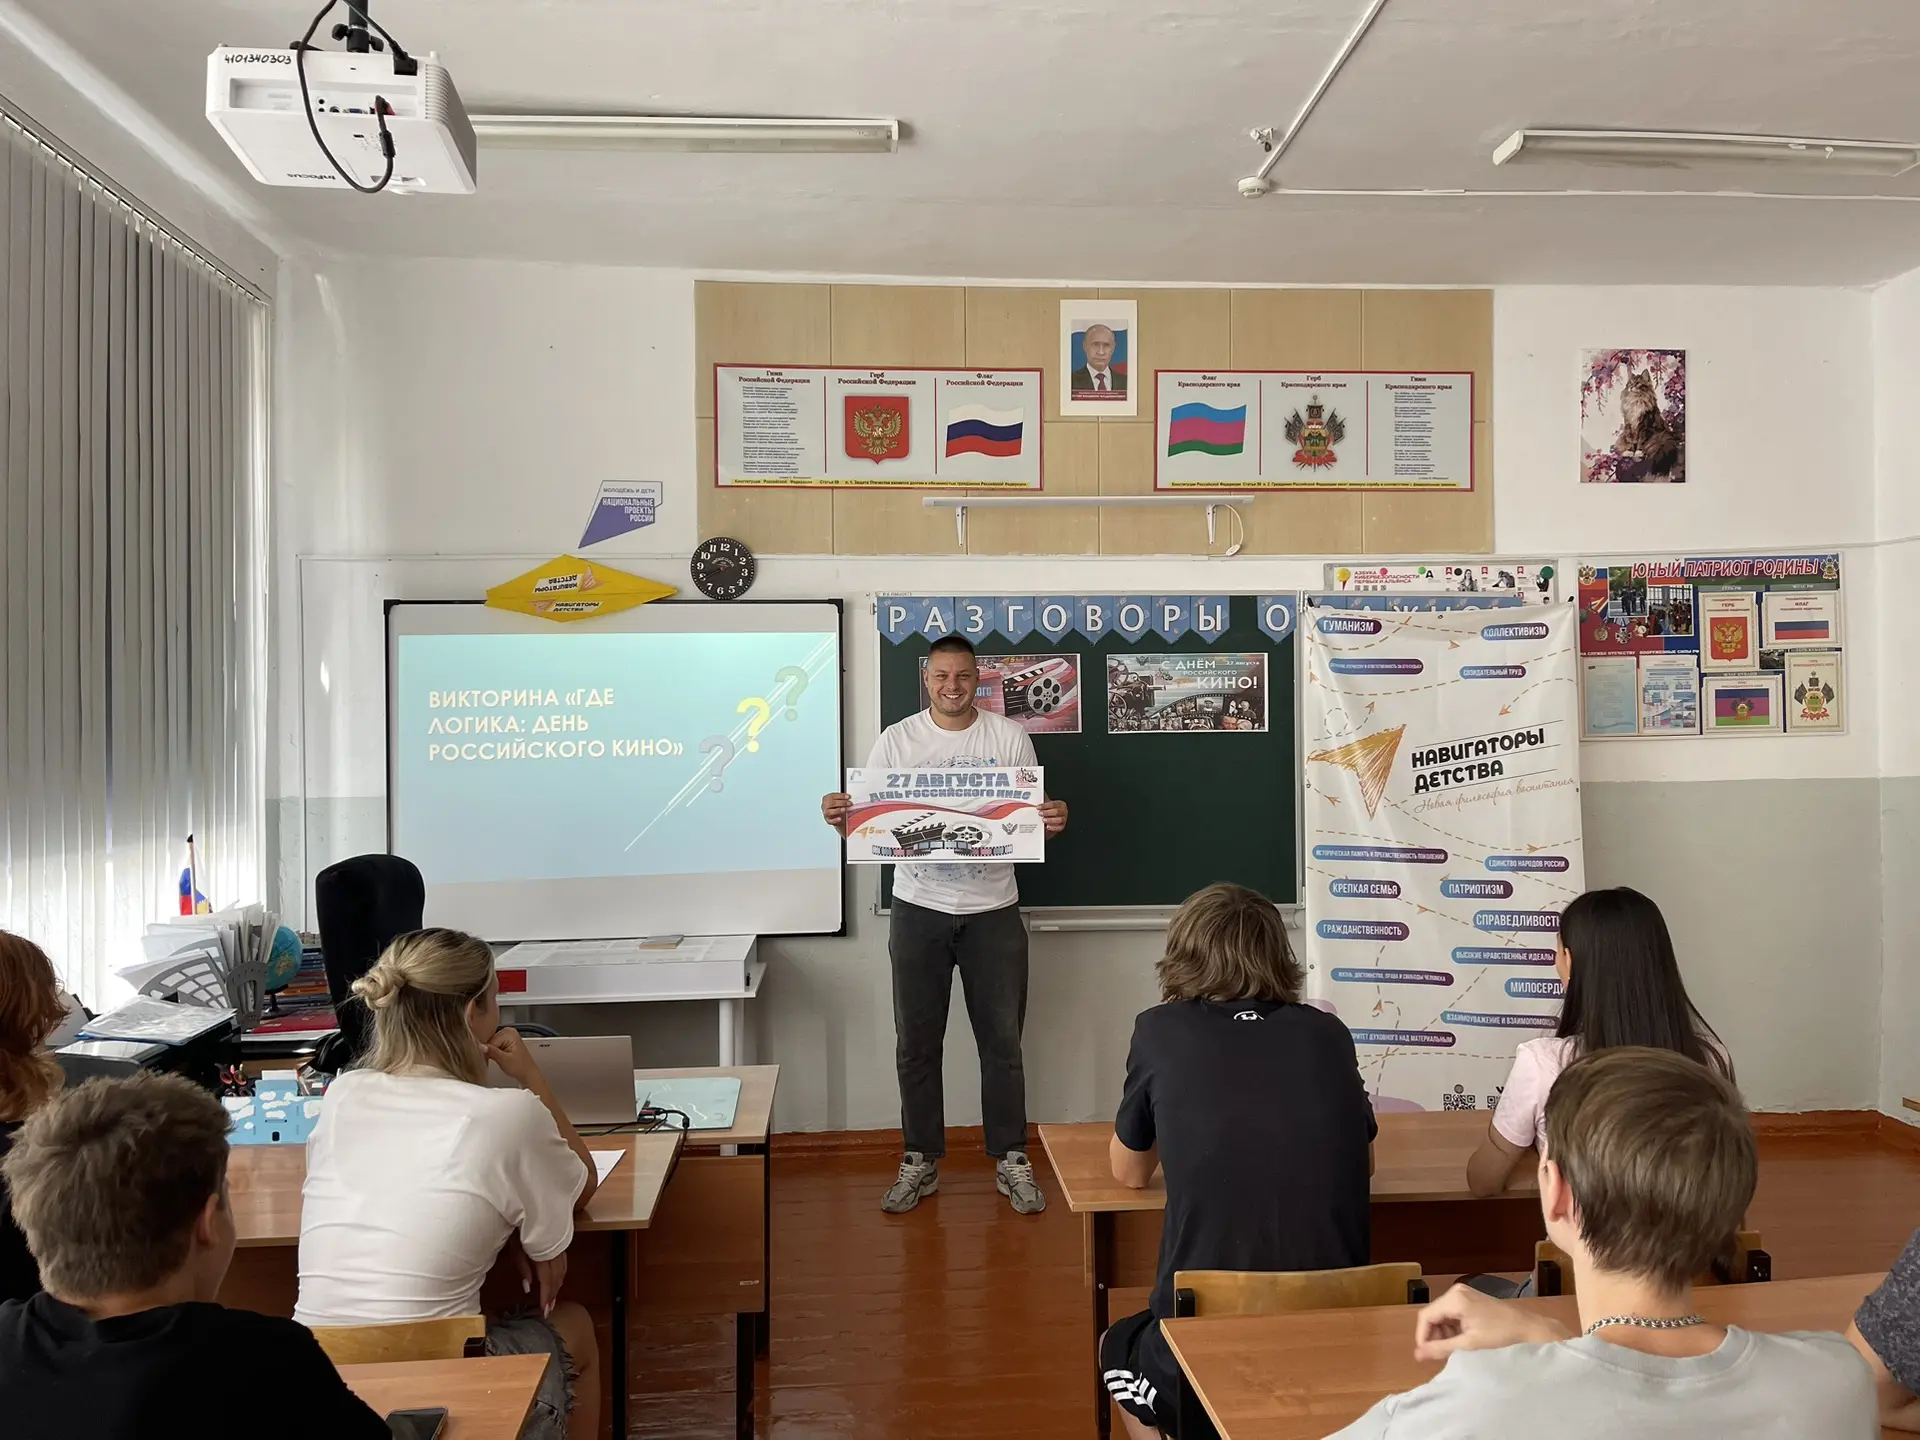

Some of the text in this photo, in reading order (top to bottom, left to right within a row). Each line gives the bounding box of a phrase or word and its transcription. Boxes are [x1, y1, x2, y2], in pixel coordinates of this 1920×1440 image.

[224, 54, 291, 65] 4101340303
[738, 376, 811, 385] Российской Федерации
[946, 379, 1024, 388] Российской Федерации
[1178, 381, 1226, 389] Краснодарского
[1281, 382, 1331, 390] Краснодарского
[1385, 383, 1436, 391] Краснодарского
[602, 498, 654, 507] НАЦИОНАЛЬНЫЕ
[624, 506, 654, 514] ПРОЕКТЫ
[630, 514, 654, 522] РОССИИ
[709, 544, 717, 553] 11
[720, 543, 730, 552] 12
[734, 548, 738, 556] 1
[701, 551, 711, 560] 10
[739, 556, 747, 565] 2
[696, 561, 704, 570] 9
[1632, 558, 1818, 579] ЮНЫЙ ПАТРИОТ РОДИНЫ
[741, 568, 748, 577] 3
[706, 582, 713, 591] 7
[736, 578, 743, 587] 4
[716, 586, 725, 595] 6
[728, 585, 736, 594] 5
[889, 604, 1290, 633] РАЗГОВОРЫ О
[1323, 620, 1374, 632] ГУМАНИЗМ
[1483, 626, 1547, 637] КОЛЛЕКТИВИЗМ
[1161, 660, 1170, 670] С
[1175, 658, 1216, 670] ДНЁМ
[1463, 667, 1523, 676] СОЗИДАТЕЛЬНЫЙ ТРУД
[1196, 676, 1258, 689] КИНО!
[429, 688, 615, 708] ВИКТОРИНА «ГДЕ
[428, 714, 589, 735] ЛОГИКА: ДЕНЬ
[429, 737, 684, 761] РОССИЙСКОГО КИНО»
[1411, 728, 1545, 769] НАВИГАТОРЫ
[886, 773, 912, 788] 27
[915, 772, 1010, 788] АВГУСТА
[1414, 760, 1504, 794] ДЕТСТВА
[869, 790, 904, 802] ДЕНЬ
[904, 787, 995, 798] РОССИЙСКОГО
[1488, 859, 1566, 868] ЕДИНСТВО НАРОДОВ РОССИИ
[1332, 883, 1398, 895] КРЕПКАЯ СЕМЬЯ
[1448, 883, 1504, 895] ПАТРИОТИЗМ
[1323, 924, 1403, 936] ГРАЖДАНСТВЕННОСТЬ
[1456, 951, 1554, 961] ВЫСОКИЕ НРАВСТВЕННЫЕ ИДЕАЛЫ
[1510, 981, 1566, 995] МИЛОСЕРДИ
[1446, 1013, 1501, 1025] ВЗАИМОУВАЖЕНИЕ
[1369, 1033, 1398, 1042] ДУХОВНОГО
[1400, 1034, 1410, 1042] НАД
[1410, 1035, 1453, 1043] МАТЕРИАЛЬНЫМ
